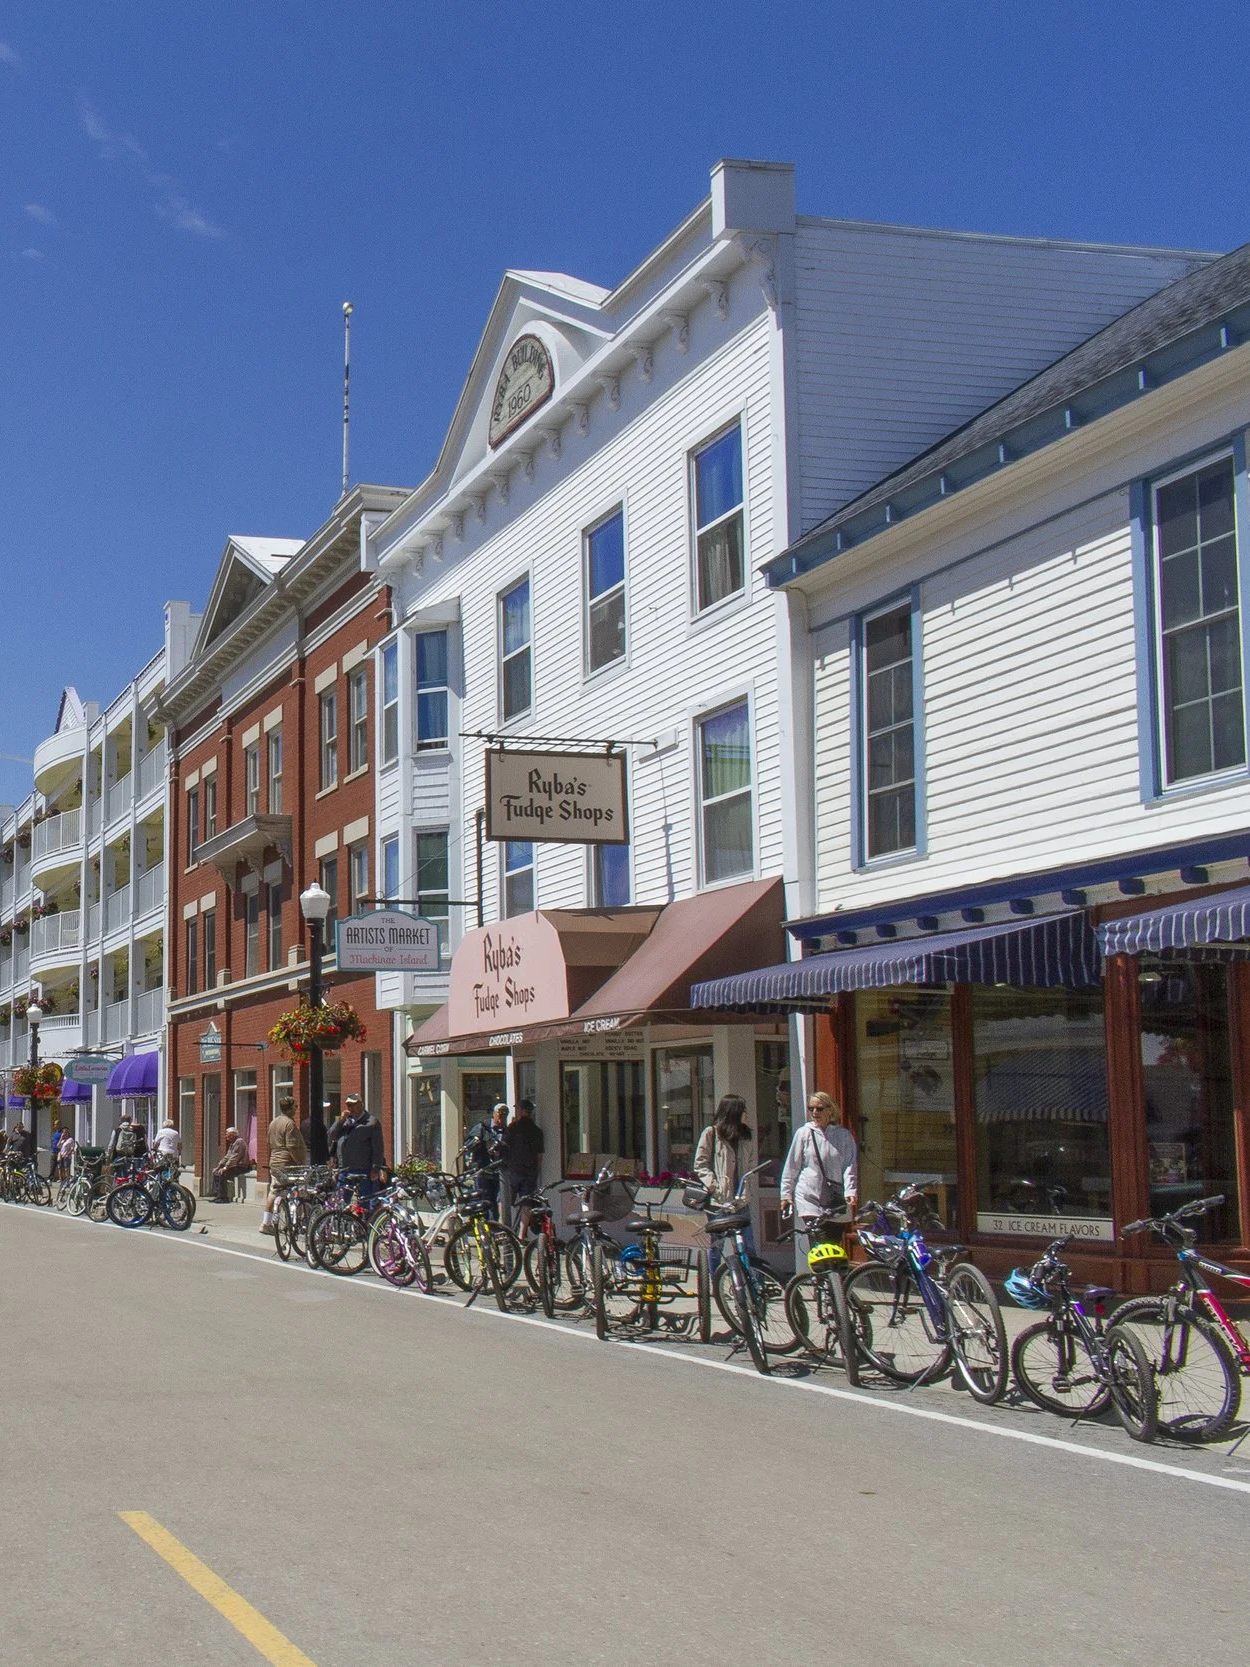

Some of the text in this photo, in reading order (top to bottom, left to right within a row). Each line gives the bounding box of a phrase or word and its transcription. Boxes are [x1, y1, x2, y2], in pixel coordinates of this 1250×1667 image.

[512, 343, 546, 380] BUILDING
[508, 384, 531, 418] 1960
[528, 768, 587, 801] Ryba's
[499, 794, 614, 826] Fudge Shops
[346, 927, 430, 945] ARTISTS MARKET
[350, 954, 428, 965] Mackinac Island
[483, 932, 522, 982] Ryba's
[473, 976, 535, 1018] Fudge Shops
[489, 1033, 523, 1047] CHOCOLATES
[584, 1018, 620, 1033] ICE CREAM
[993, 1219, 1100, 1236] 32 ICE CREAM FLAVORS
